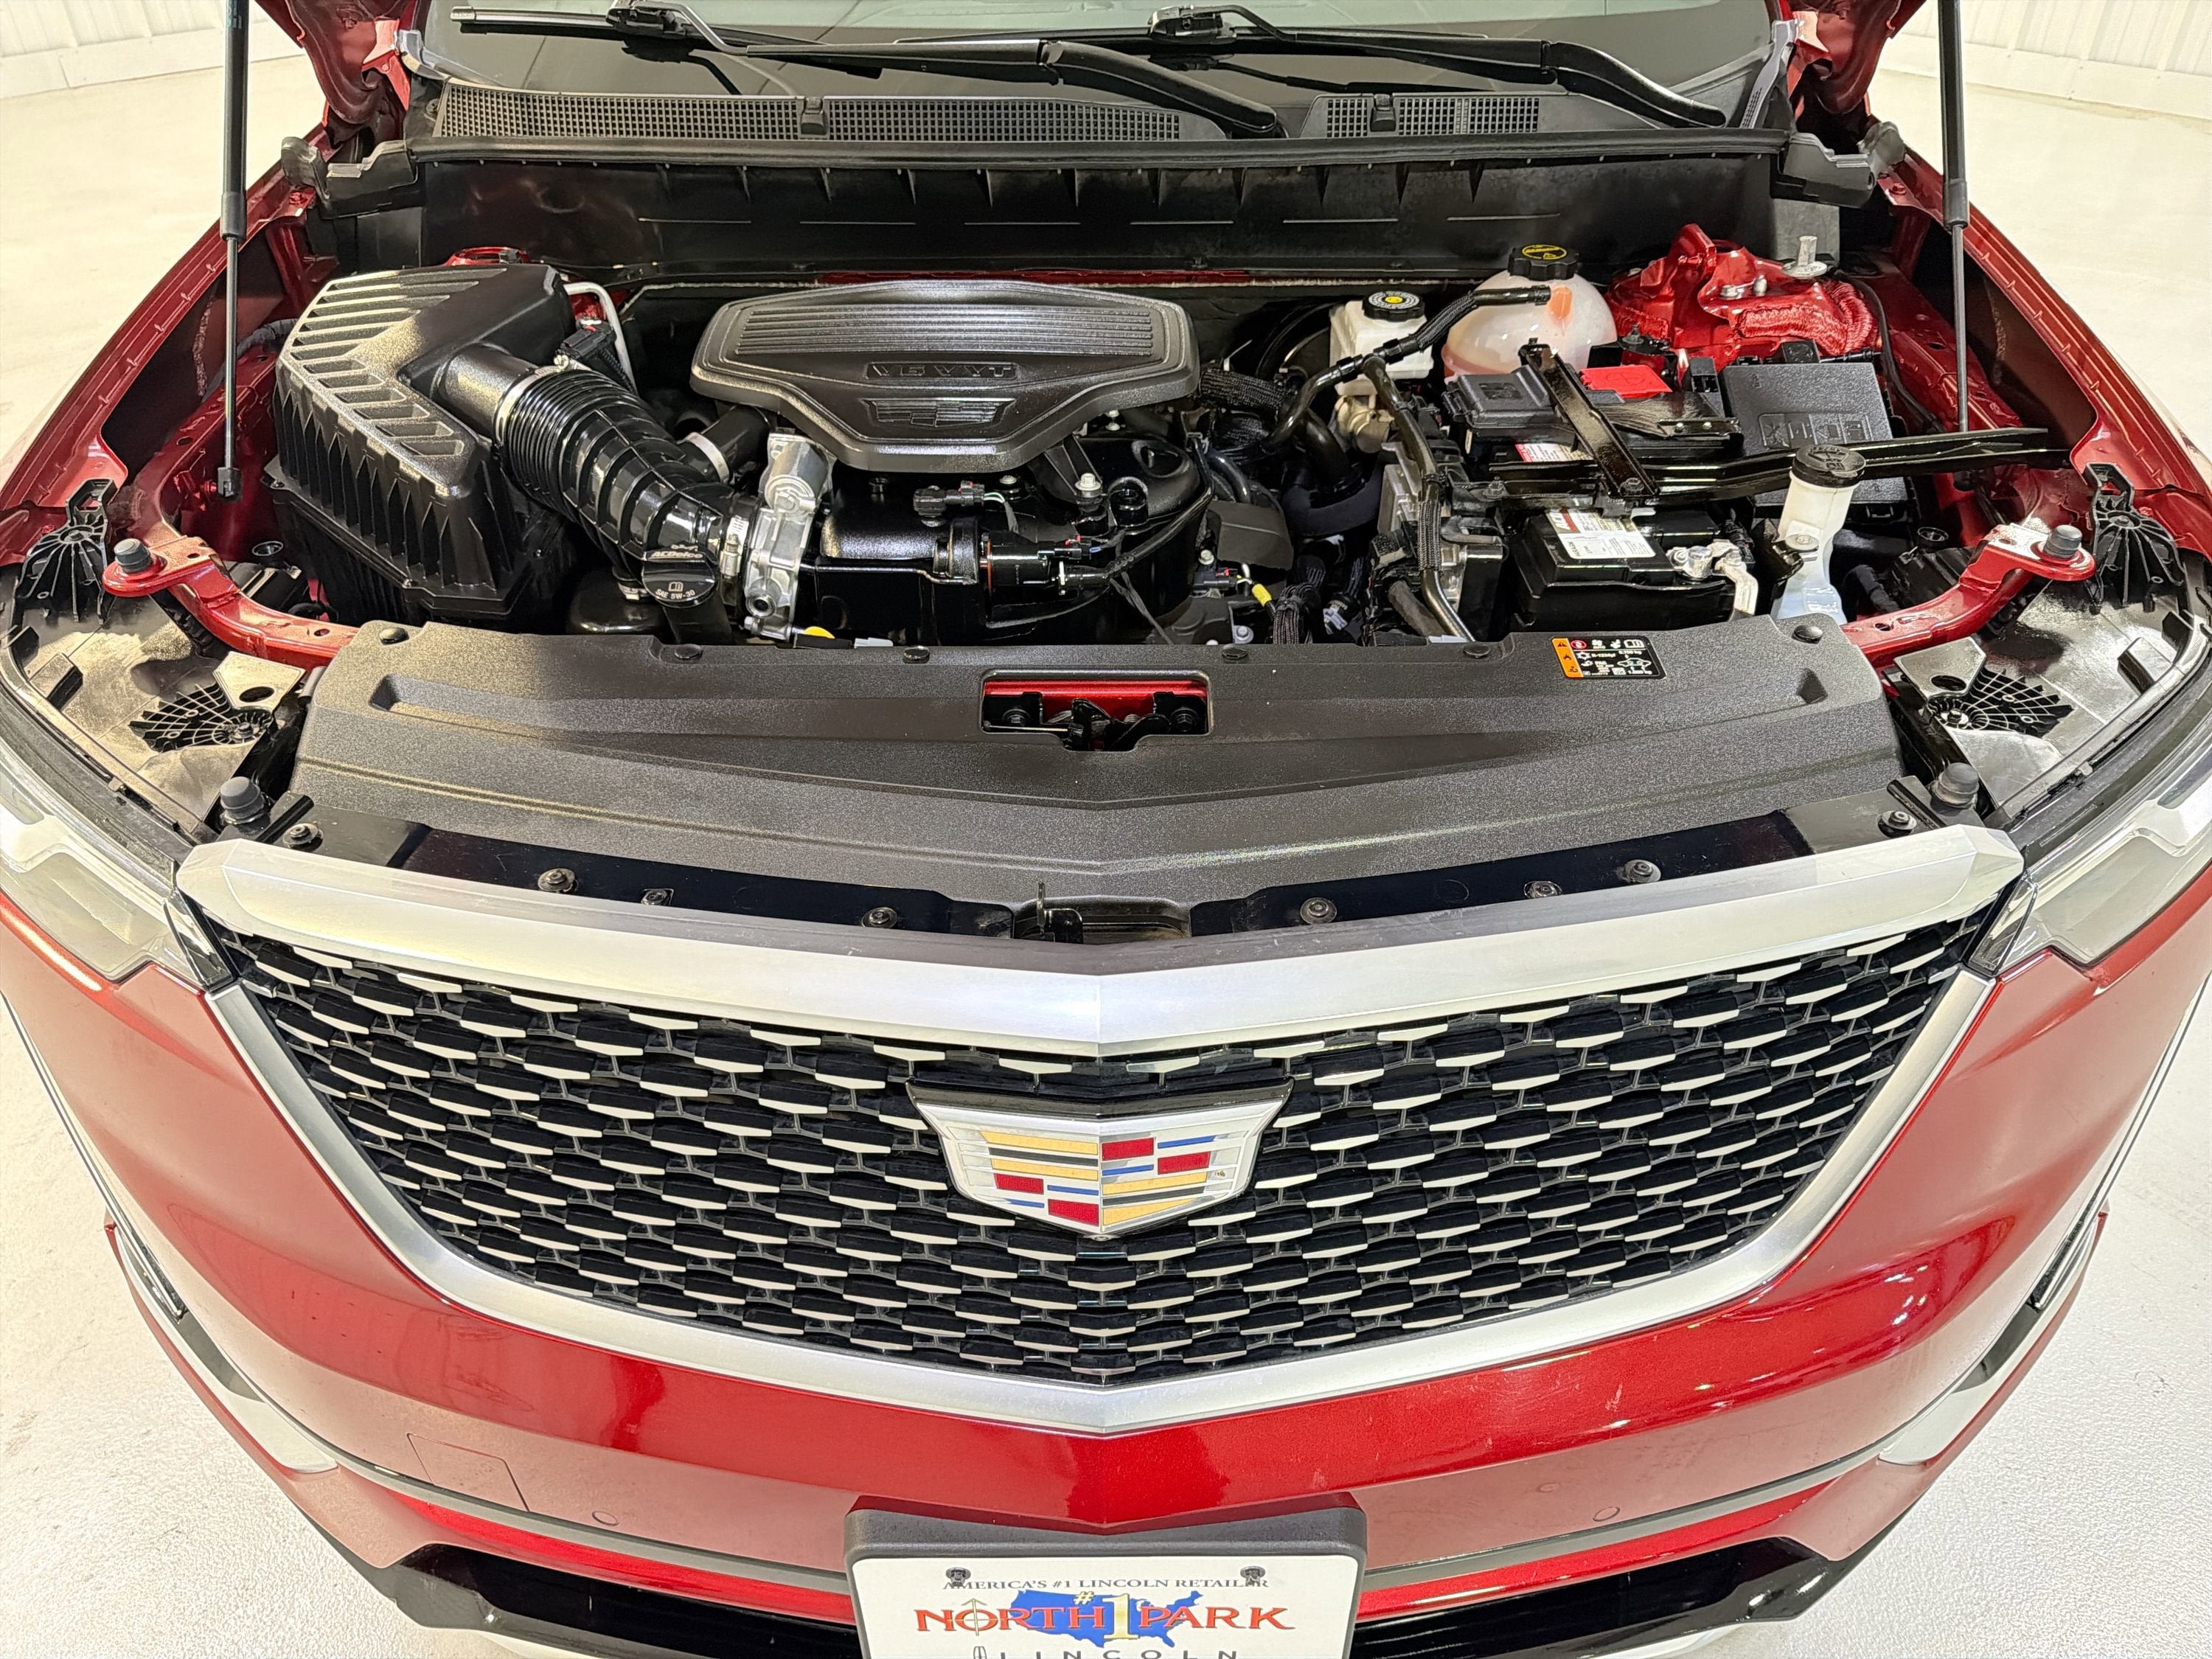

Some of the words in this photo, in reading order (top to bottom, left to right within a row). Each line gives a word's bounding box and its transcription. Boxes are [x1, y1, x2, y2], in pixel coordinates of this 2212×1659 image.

[650, 551, 703, 559] ACDelco
[655, 588, 669, 599] SAE
[670, 589, 696, 600] 5W-30
[1052, 1580, 1071, 1588] #1
[1079, 1579, 1169, 1588] LINCOLN
[1175, 1579, 1269, 1588] RETAILR
[914, 1606, 1105, 1632] NORTH
[1139, 1606, 1296, 1630] PARK
